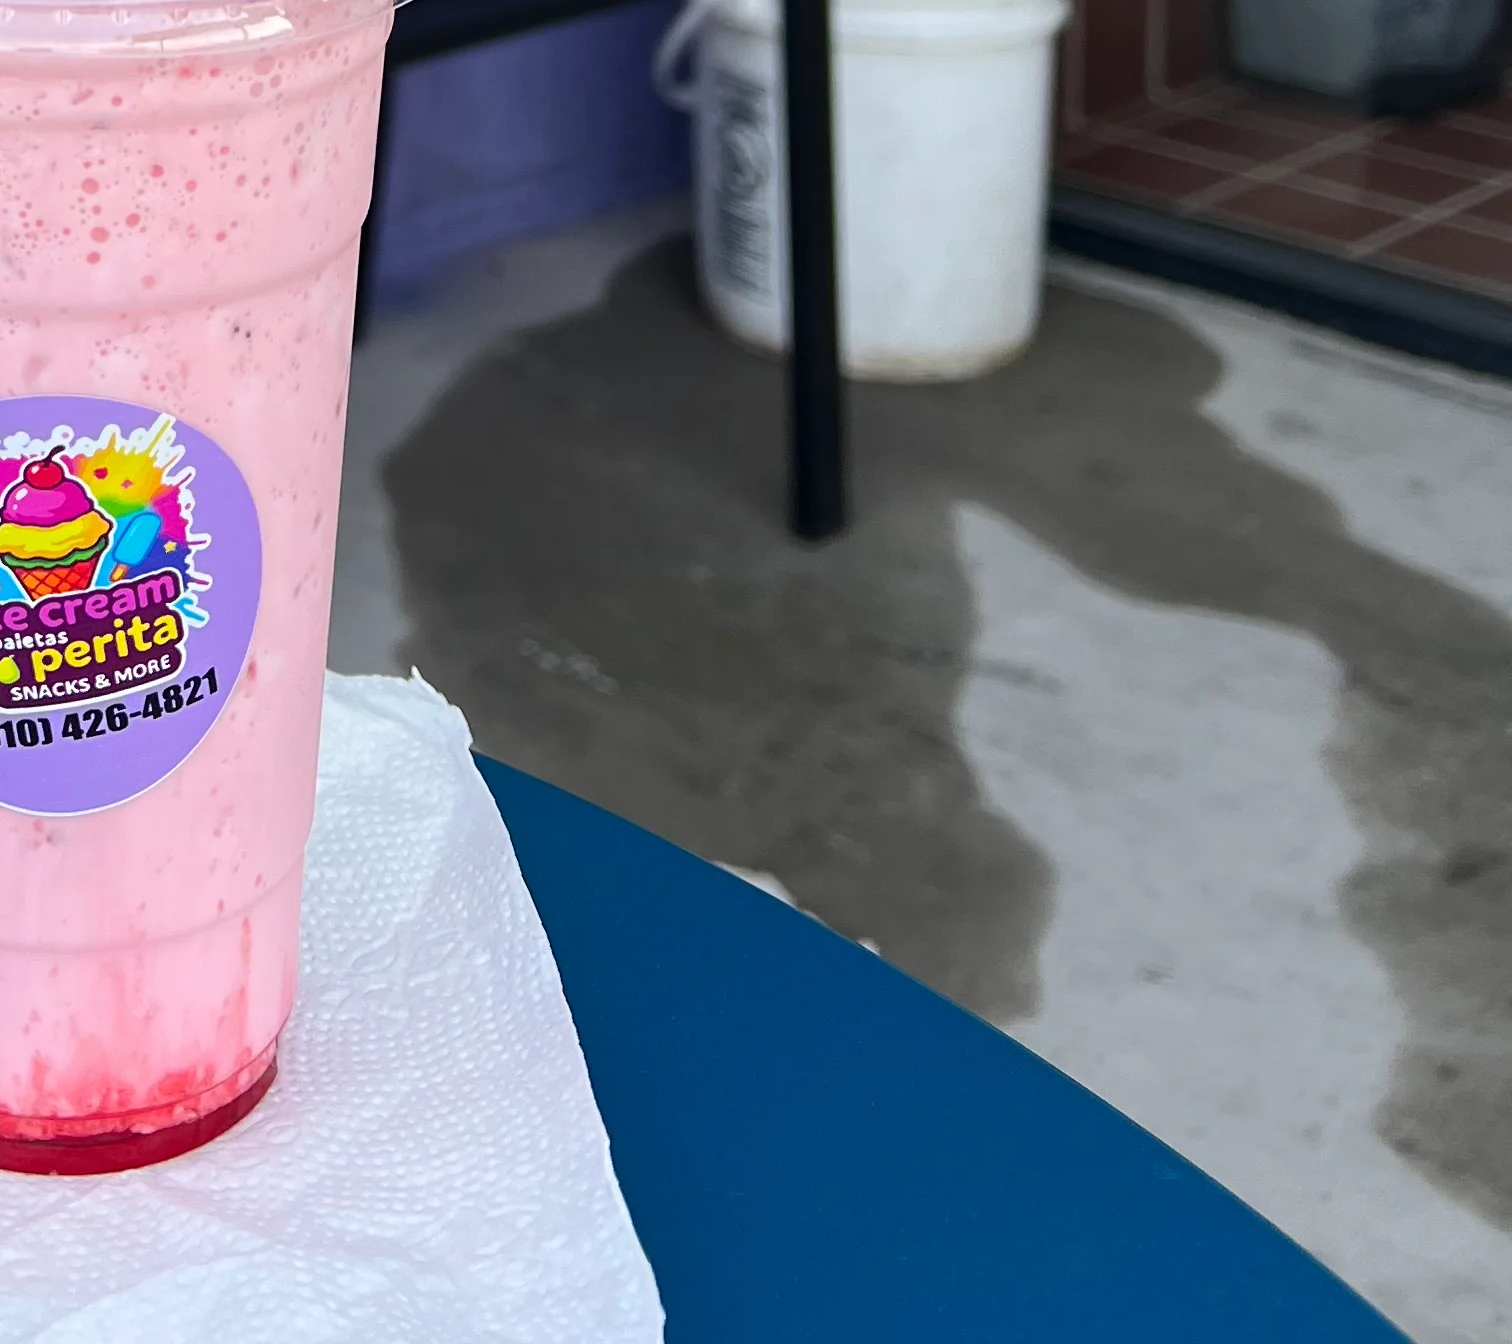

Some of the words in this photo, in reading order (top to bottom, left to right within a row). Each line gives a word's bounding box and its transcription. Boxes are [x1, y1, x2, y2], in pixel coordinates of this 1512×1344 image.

[39, 575, 175, 627] cream
[9, 678, 91, 702] SNACKS
[95, 673, 111, 689] &
[114, 654, 171, 684] MORE
[31, 614, 179, 682] perita
[61, 667, 218, 741] 426-4821
